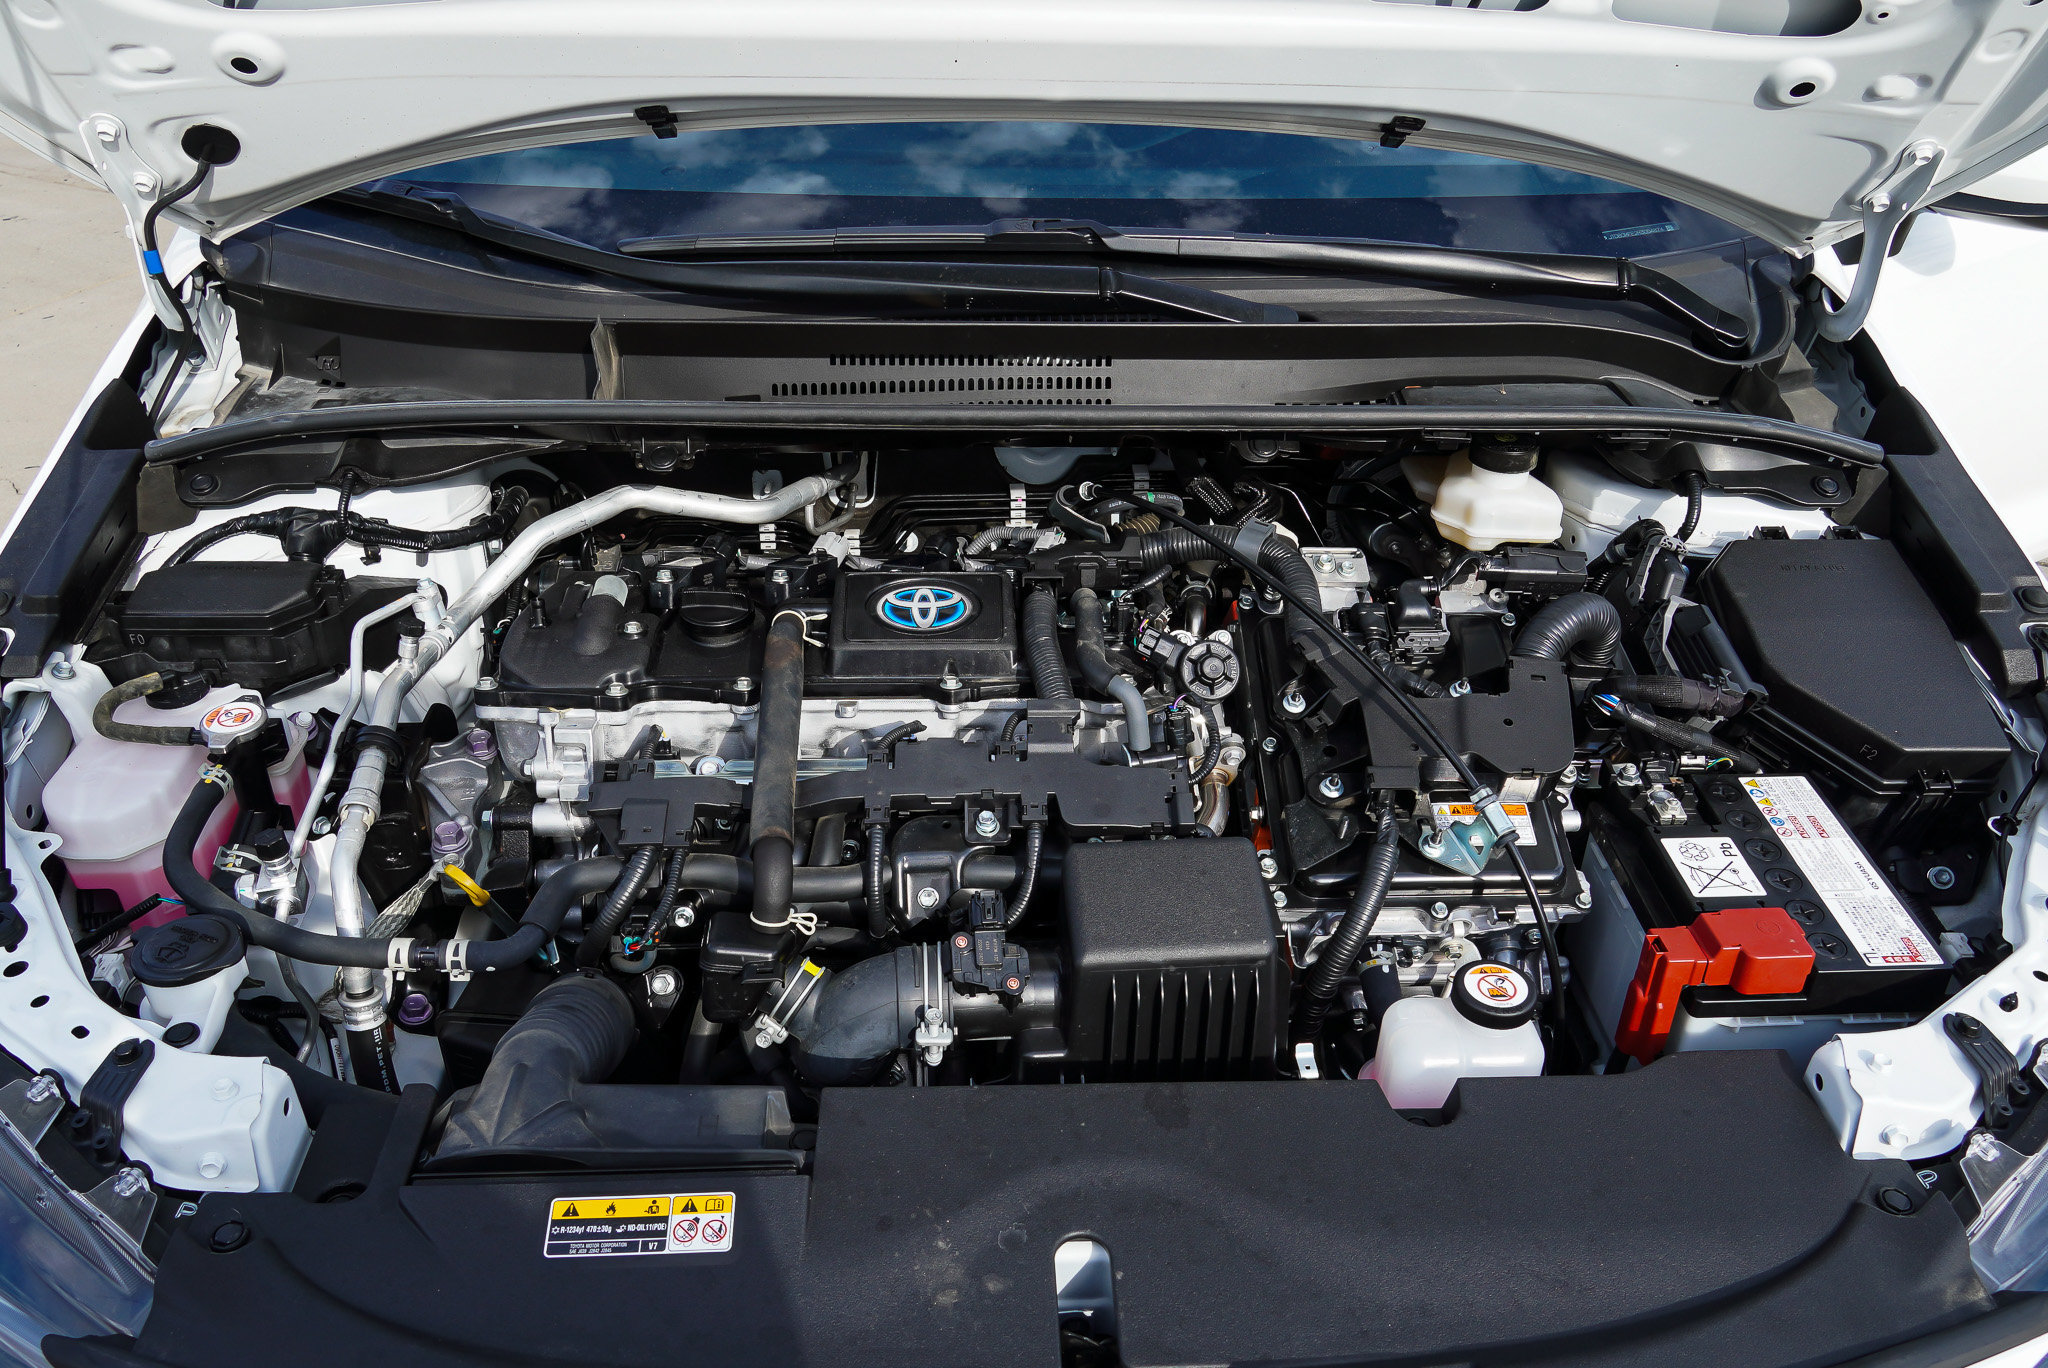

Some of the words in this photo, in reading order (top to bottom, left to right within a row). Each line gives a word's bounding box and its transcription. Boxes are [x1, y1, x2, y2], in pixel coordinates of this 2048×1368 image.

[1859, 744, 1878, 760] F2
[1720, 842, 1737, 856] Pb
[1854, 861, 1873, 881] YUASA
[1868, 881, 1880, 889] GS
[1901, 937, 1920, 955] DANGER
[648, 1242, 658, 1250] V7
